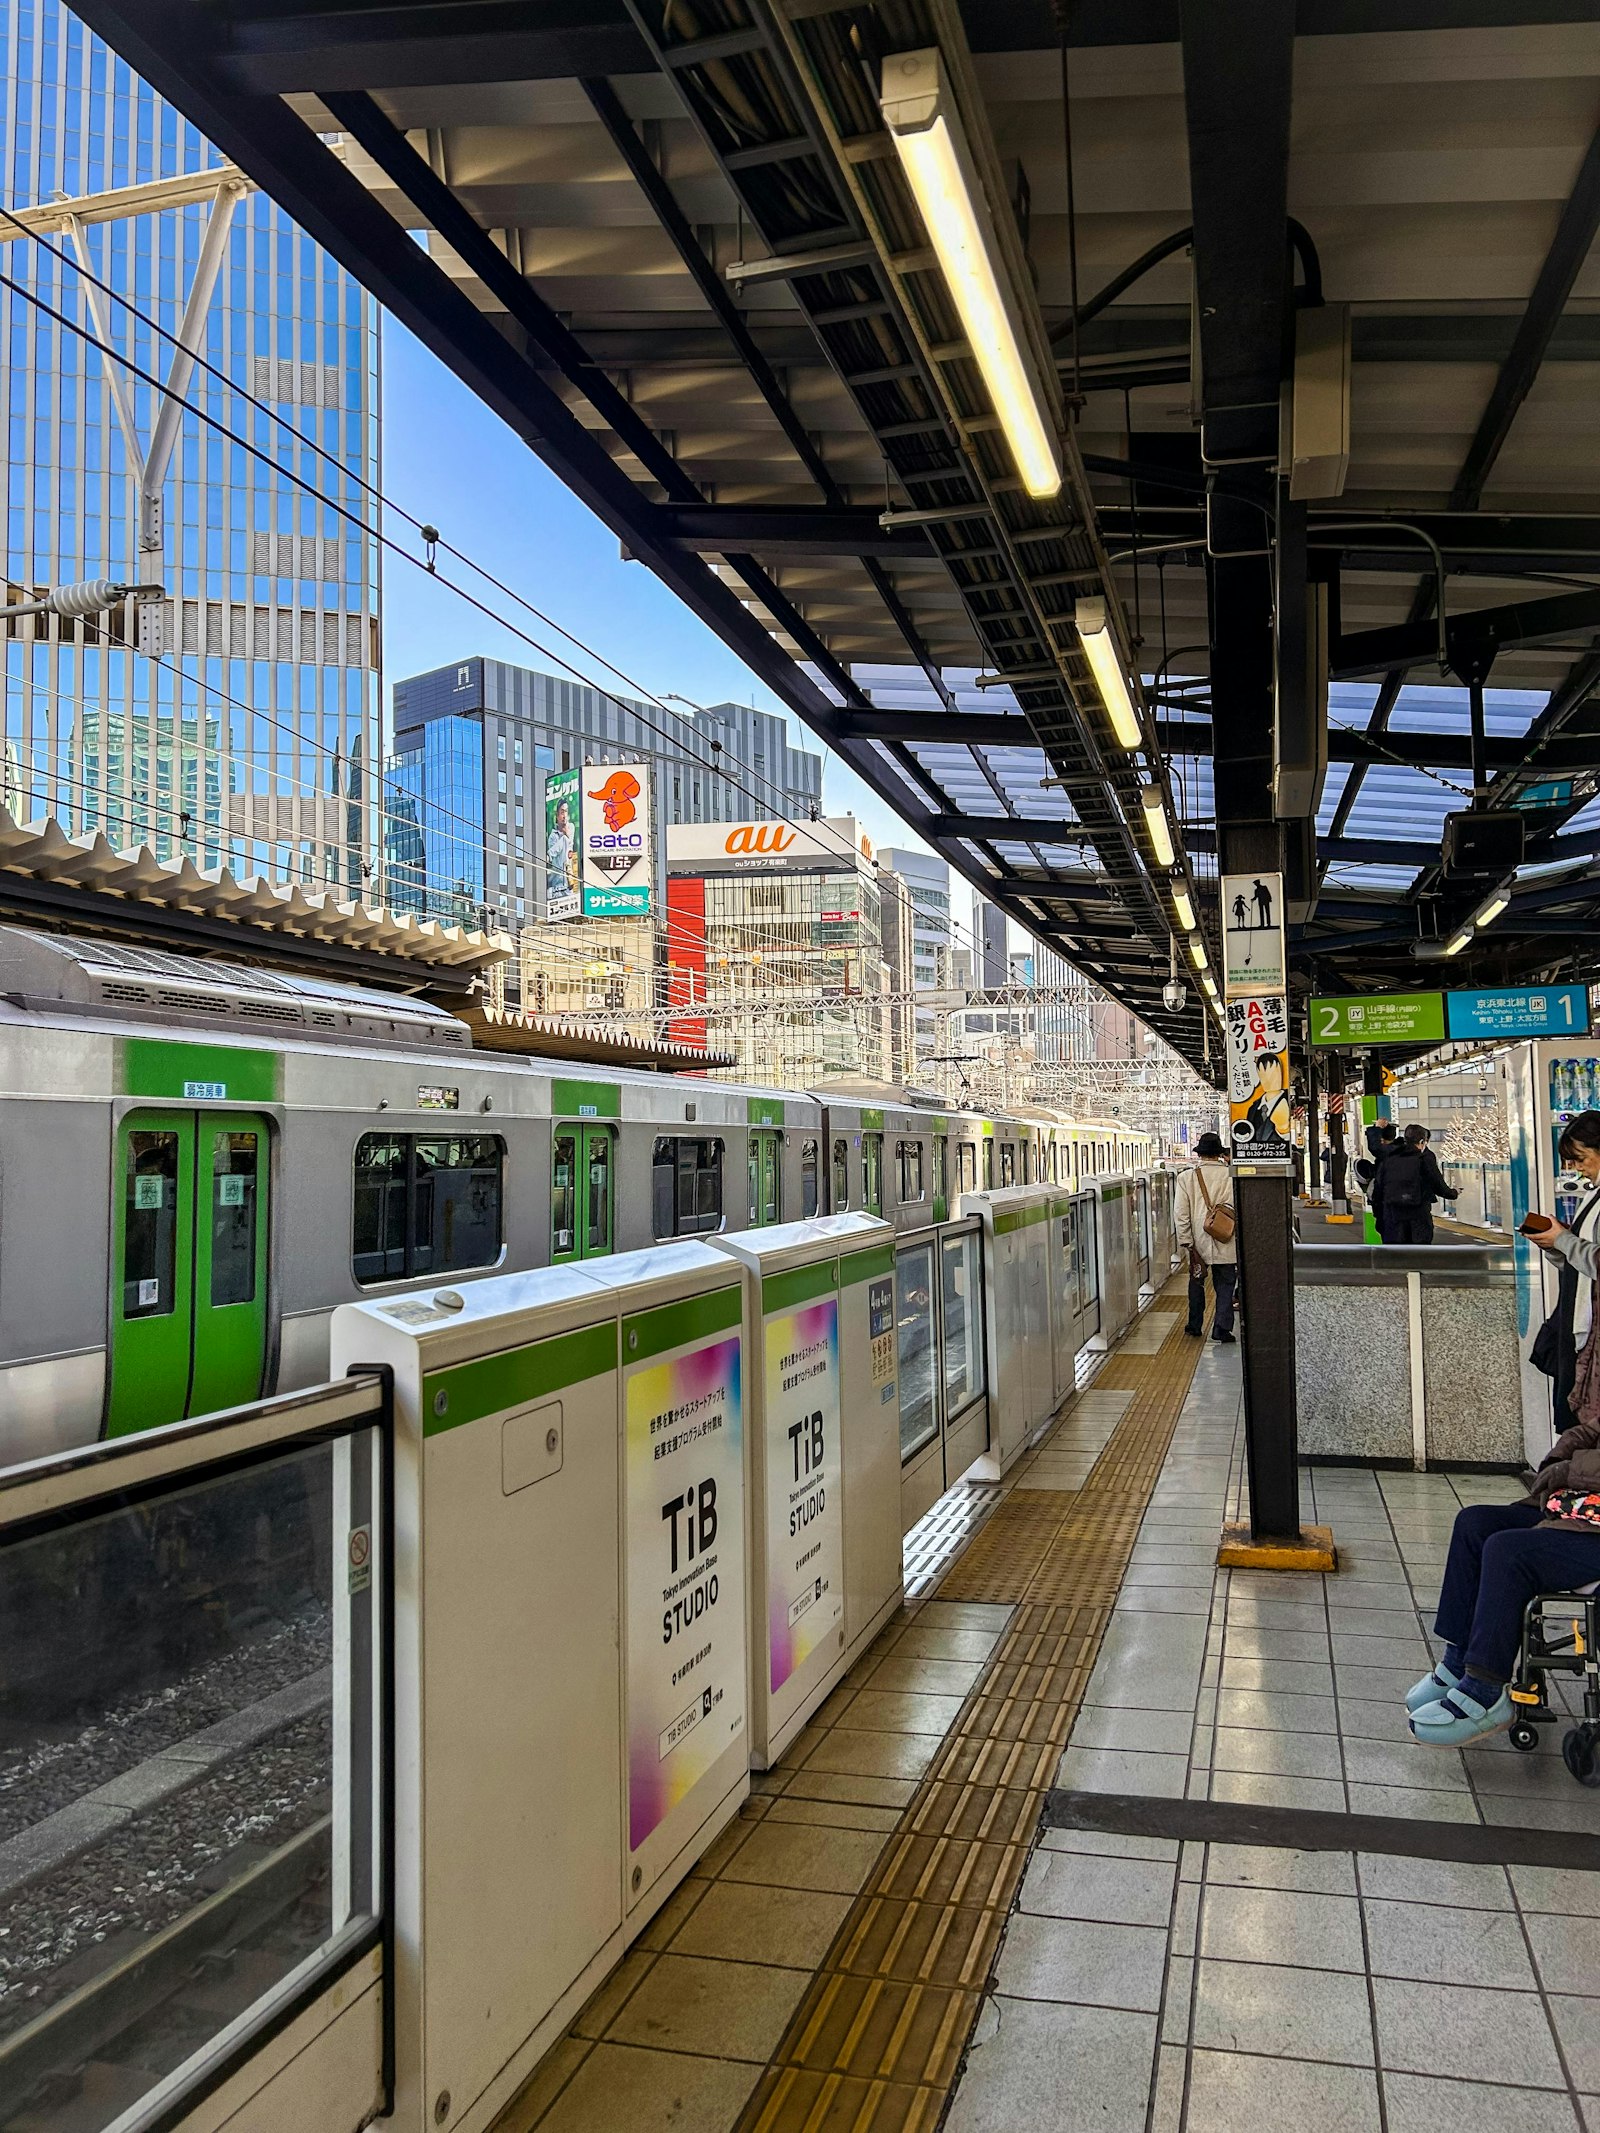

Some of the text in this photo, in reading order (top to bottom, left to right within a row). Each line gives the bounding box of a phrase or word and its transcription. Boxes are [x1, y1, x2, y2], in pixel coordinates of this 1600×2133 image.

[589, 833, 642, 848] sato
[724, 825, 797, 854] au
[1247, 1001, 1267, 1051] AGA
[1320, 1007, 1340, 1036] 2
[1477, 997, 1526, 1008] 京浜東北線
[1557, 994, 1573, 1025] 1
[187, 1083, 223, 1097] 弱冷房車
[650, 1386, 725, 1434] 世界を驚かせるスタートアップを
[654, 1414, 722, 1461] 起業支援プログラム受付開始
[788, 1410, 824, 1483] TiB
[662, 1477, 718, 1574] TiB
[789, 1488, 825, 1537] STUDIO
[662, 1554, 718, 1602] Tokyo Innovation Base
[663, 1574, 718, 1644] STUDIO
[677, 1708, 697, 1736] STUDIO
